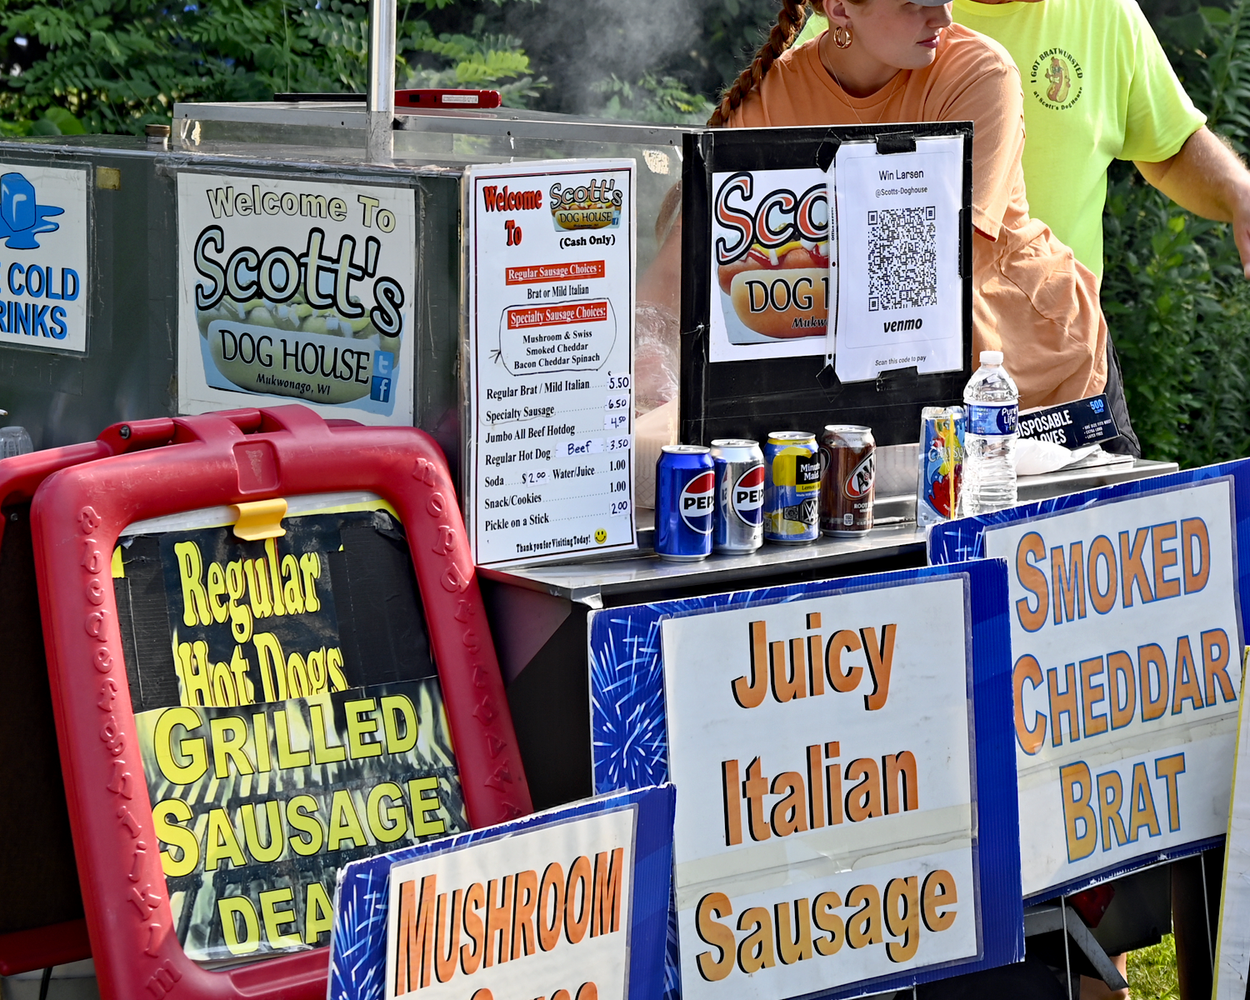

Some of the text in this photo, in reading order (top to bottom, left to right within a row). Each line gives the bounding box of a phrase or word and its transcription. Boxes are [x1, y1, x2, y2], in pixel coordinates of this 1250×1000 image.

[1030, 59, 1041, 77] GOT
[1038, 47, 1083, 79] BRATWURSTED
[879, 169, 924, 181] Win Larsen
[482, 185, 543, 213] Welcome
[549, 178, 623, 210] Scott's
[875, 187, 928, 198] @Scotts-Doghouse
[206, 184, 397, 233] Welcome To
[559, 211, 612, 223] DOG HOUSE
[504, 219, 523, 247] To
[560, 234, 616, 249] (Cash Only)
[7, 261, 80, 302] COLD
[194, 225, 405, 338] Scott's
[508, 263, 597, 281] Regular Sausage Choices
[527, 288, 542, 299] Brat
[552, 285, 567, 297] Mild
[568, 284, 589, 295] Italian
[744, 277, 814, 314] DOG
[0, 300, 68, 341] RINKS
[510, 305, 606, 327] Specialty Sausage Choices:
[791, 315, 828, 330] Mukw
[883, 317, 923, 333] venmo
[522, 332, 562, 344] Mushroom
[573, 329, 593, 339] Swiss
[526, 342, 589, 356] Smoked Cheddar
[218, 329, 371, 385] DOG HOUSE
[514, 352, 600, 370] Bacon Cheddar Spinach
[875, 358, 888, 366] Scan
[889, 357, 898, 366] this
[899, 356, 911, 364] code
[917, 355, 927, 364] pay
[256, 372, 332, 396] Mukwonago, WI
[486, 386, 518, 401] Regular
[520, 384, 538, 396] Brat
[544, 381, 563, 393] Mild
[565, 379, 590, 391] Italian
[608, 377, 629, 389] 5.50
[486, 399, 627, 424] Specialty Sausage 6.50
[1089, 398, 1104, 410] 500
[485, 430, 513, 444] Jumbo
[514, 428, 526, 440] All
[528, 425, 546, 438] Beef
[547, 423, 576, 437] Hotdog
[1003, 416, 1016, 425] Life
[1028, 428, 1067, 445] OVES
[485, 439, 629, 467] Regular Hot Dog Beef 3.50
[484, 475, 504, 488] Soda
[552, 465, 595, 480] Water/Juice
[609, 459, 626, 472] 1.00
[484, 480, 627, 510] Snack/Cookies 1.00
[485, 500, 628, 532] Pickle on a Stick 2.00
[1014, 515, 1211, 632] SMOKED
[174, 537, 321, 642] Regular
[176, 630, 352, 708] Hot Dogs
[731, 611, 898, 712] Juicy
[1012, 627, 1237, 756] CHEDDAR
[153, 693, 420, 786] GRILLED
[721, 738, 921, 848] Italian
[1058, 751, 1187, 865] BRAT
[151, 774, 447, 878] SAUSAGE
[217, 881, 334, 955] DEA
[393, 846, 625, 998] MUSHROOM
[694, 868, 960, 984] Sausage
